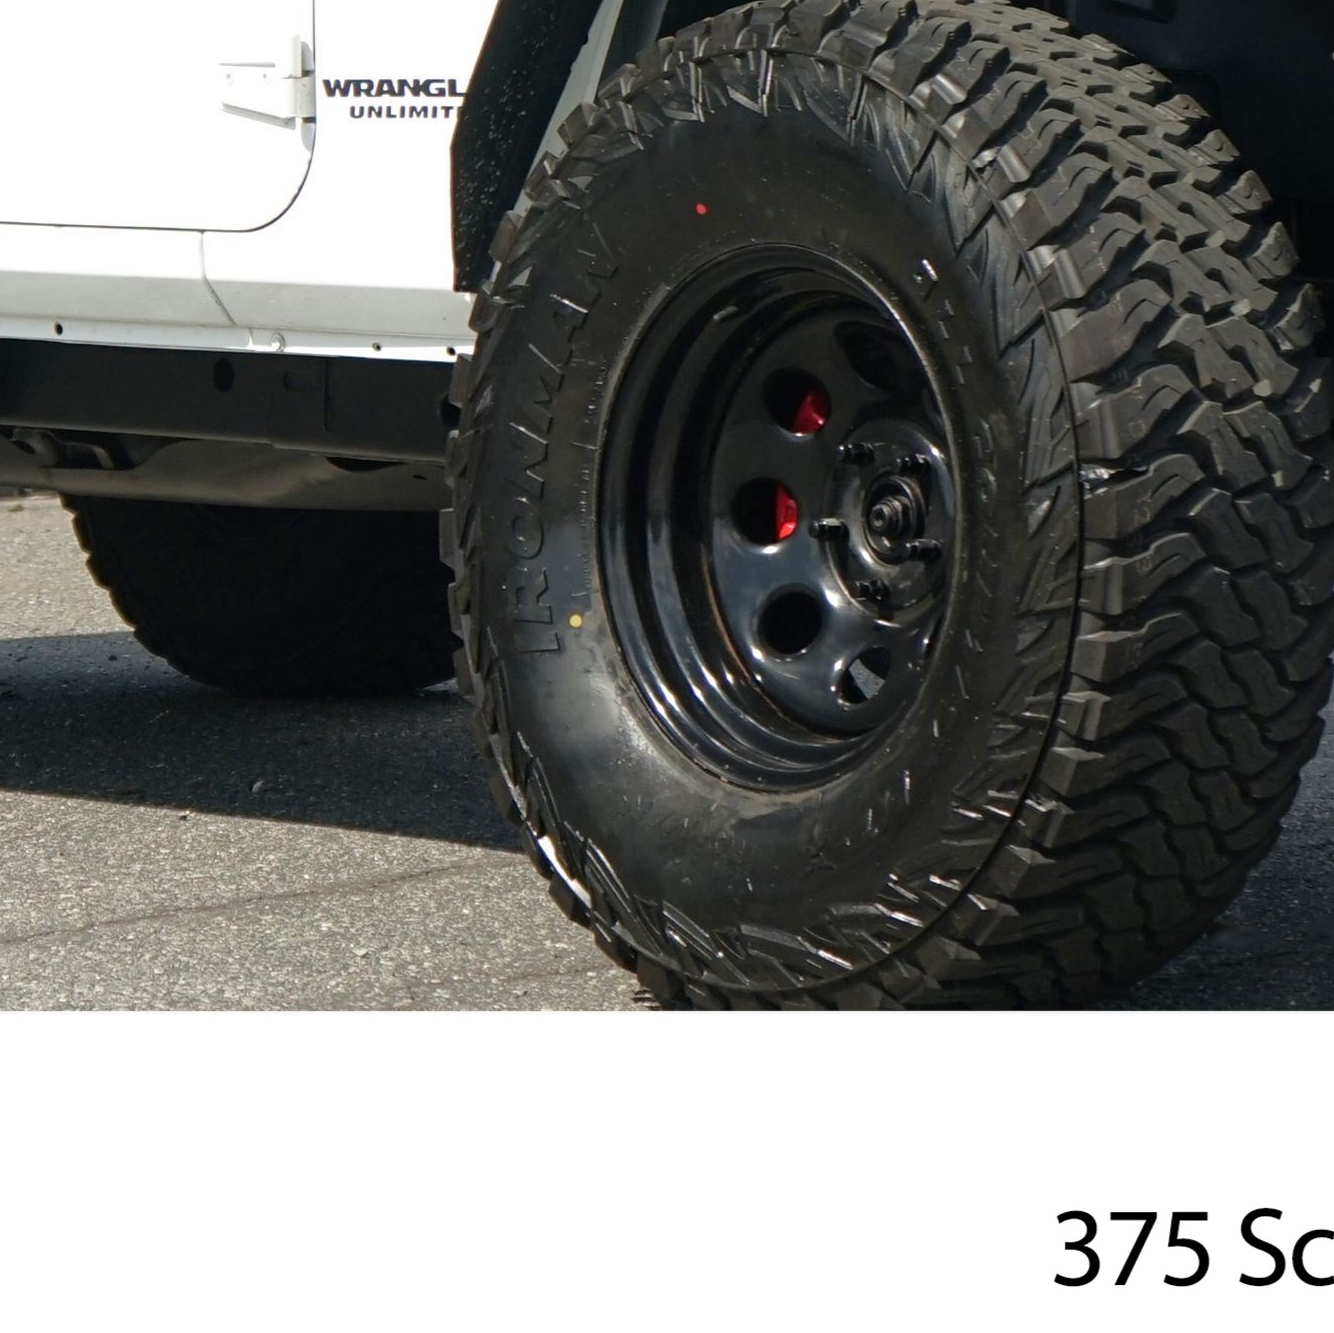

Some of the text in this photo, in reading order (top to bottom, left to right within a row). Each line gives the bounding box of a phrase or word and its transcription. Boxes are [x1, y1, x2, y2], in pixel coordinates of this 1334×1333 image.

[322, 78, 468, 98] WRANGL
[349, 105, 463, 119] UNLIMIT
[507, 219, 619, 657] IRONMAN
